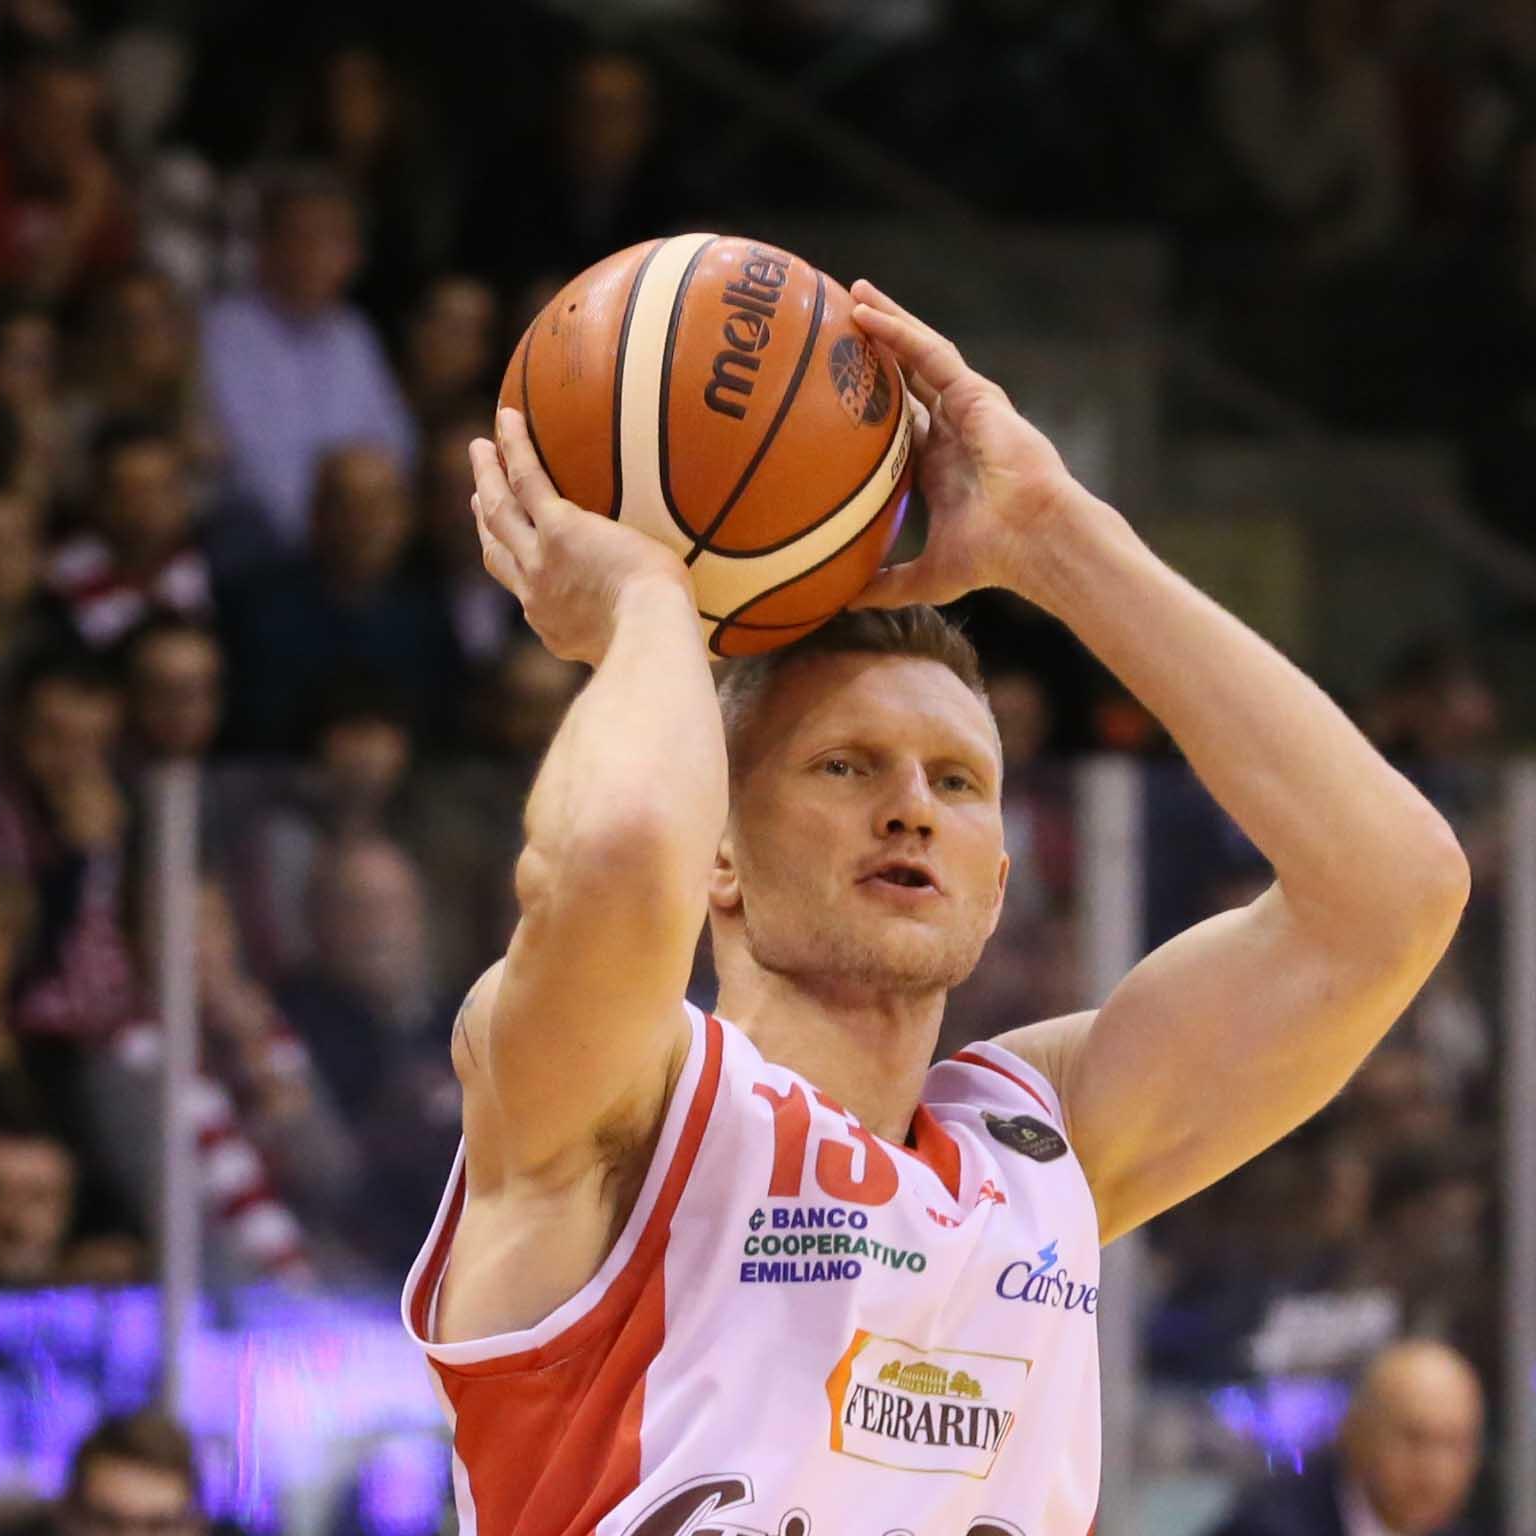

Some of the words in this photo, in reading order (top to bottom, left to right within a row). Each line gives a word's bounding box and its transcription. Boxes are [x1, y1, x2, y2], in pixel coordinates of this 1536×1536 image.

[704, 243, 793, 420] molten
[752, 1082, 899, 1207] 13
[772, 1207, 868, 1229] BANCO
[739, 1260, 862, 1283] EMILIANO
[744, 1234, 927, 1274] COOPERATIVO
[844, 1383, 1013, 1453] FERRARIN
